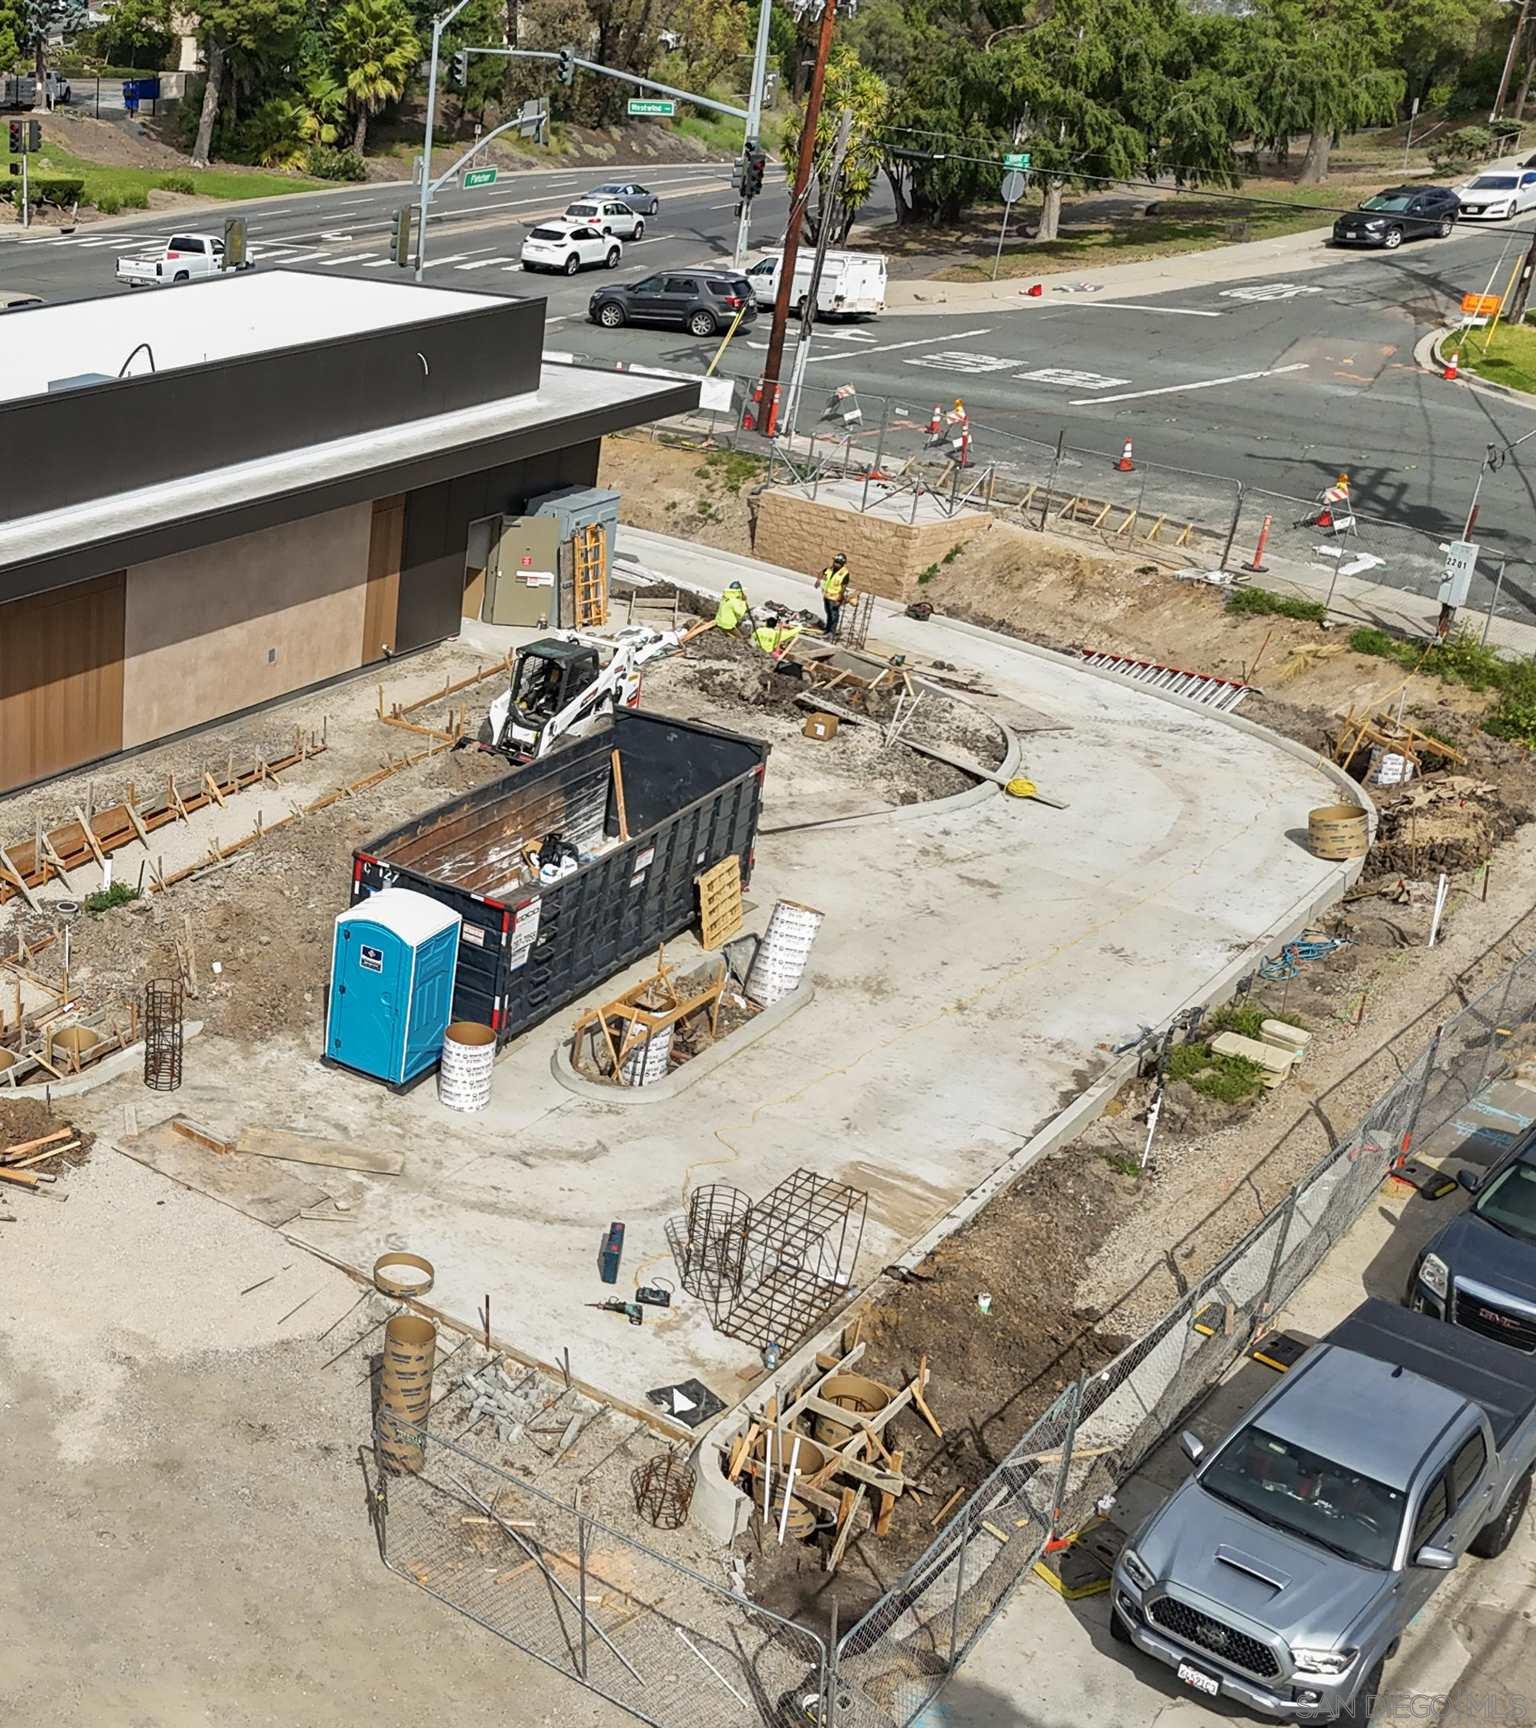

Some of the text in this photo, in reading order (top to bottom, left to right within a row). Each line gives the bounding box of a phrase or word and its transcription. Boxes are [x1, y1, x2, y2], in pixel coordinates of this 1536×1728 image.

[1446, 557, 1468, 570] 2201
[378, 866, 400, 884] 127
[1479, 1306, 1521, 1329] GMC
